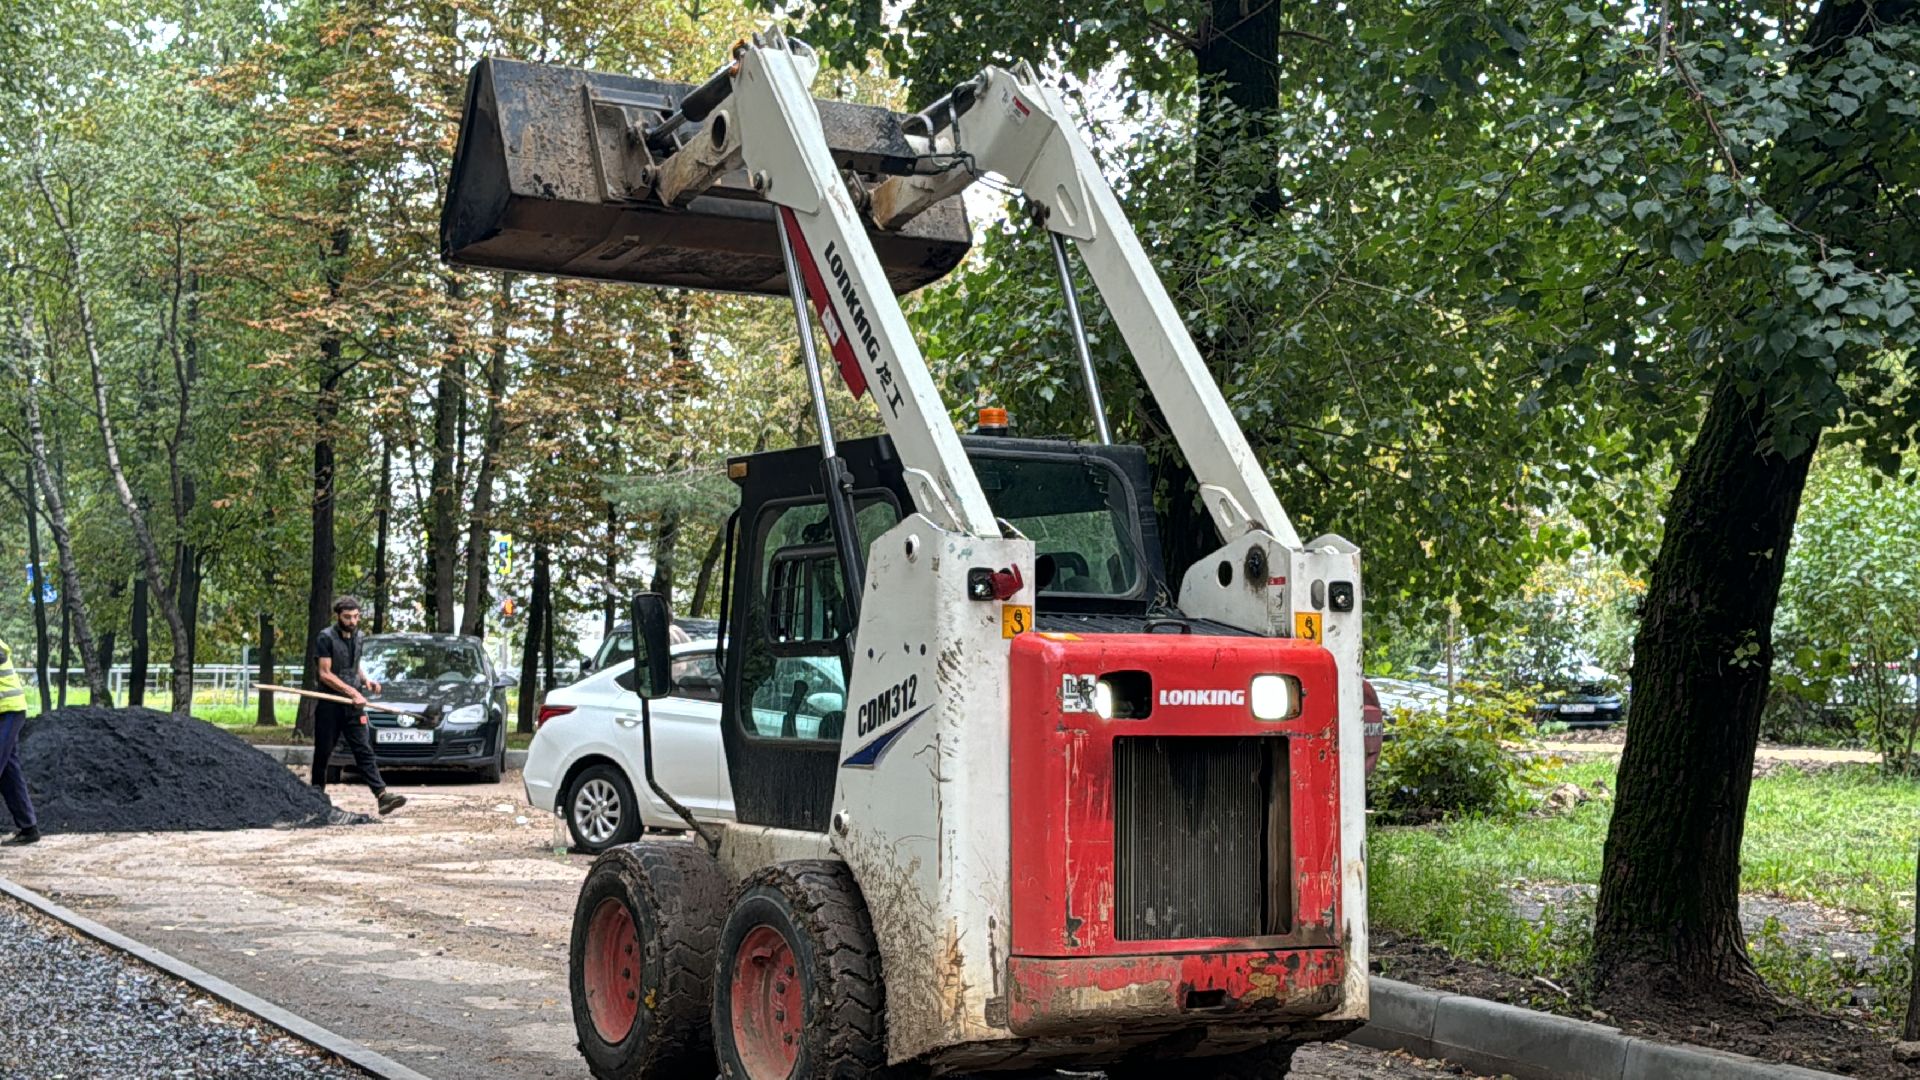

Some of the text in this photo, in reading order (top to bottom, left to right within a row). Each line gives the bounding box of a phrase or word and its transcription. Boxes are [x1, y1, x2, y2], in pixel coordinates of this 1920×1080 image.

[824, 240, 880, 363] LONKING
[858, 674, 917, 738] CDM312
[1159, 689, 1245, 706] LONKING
